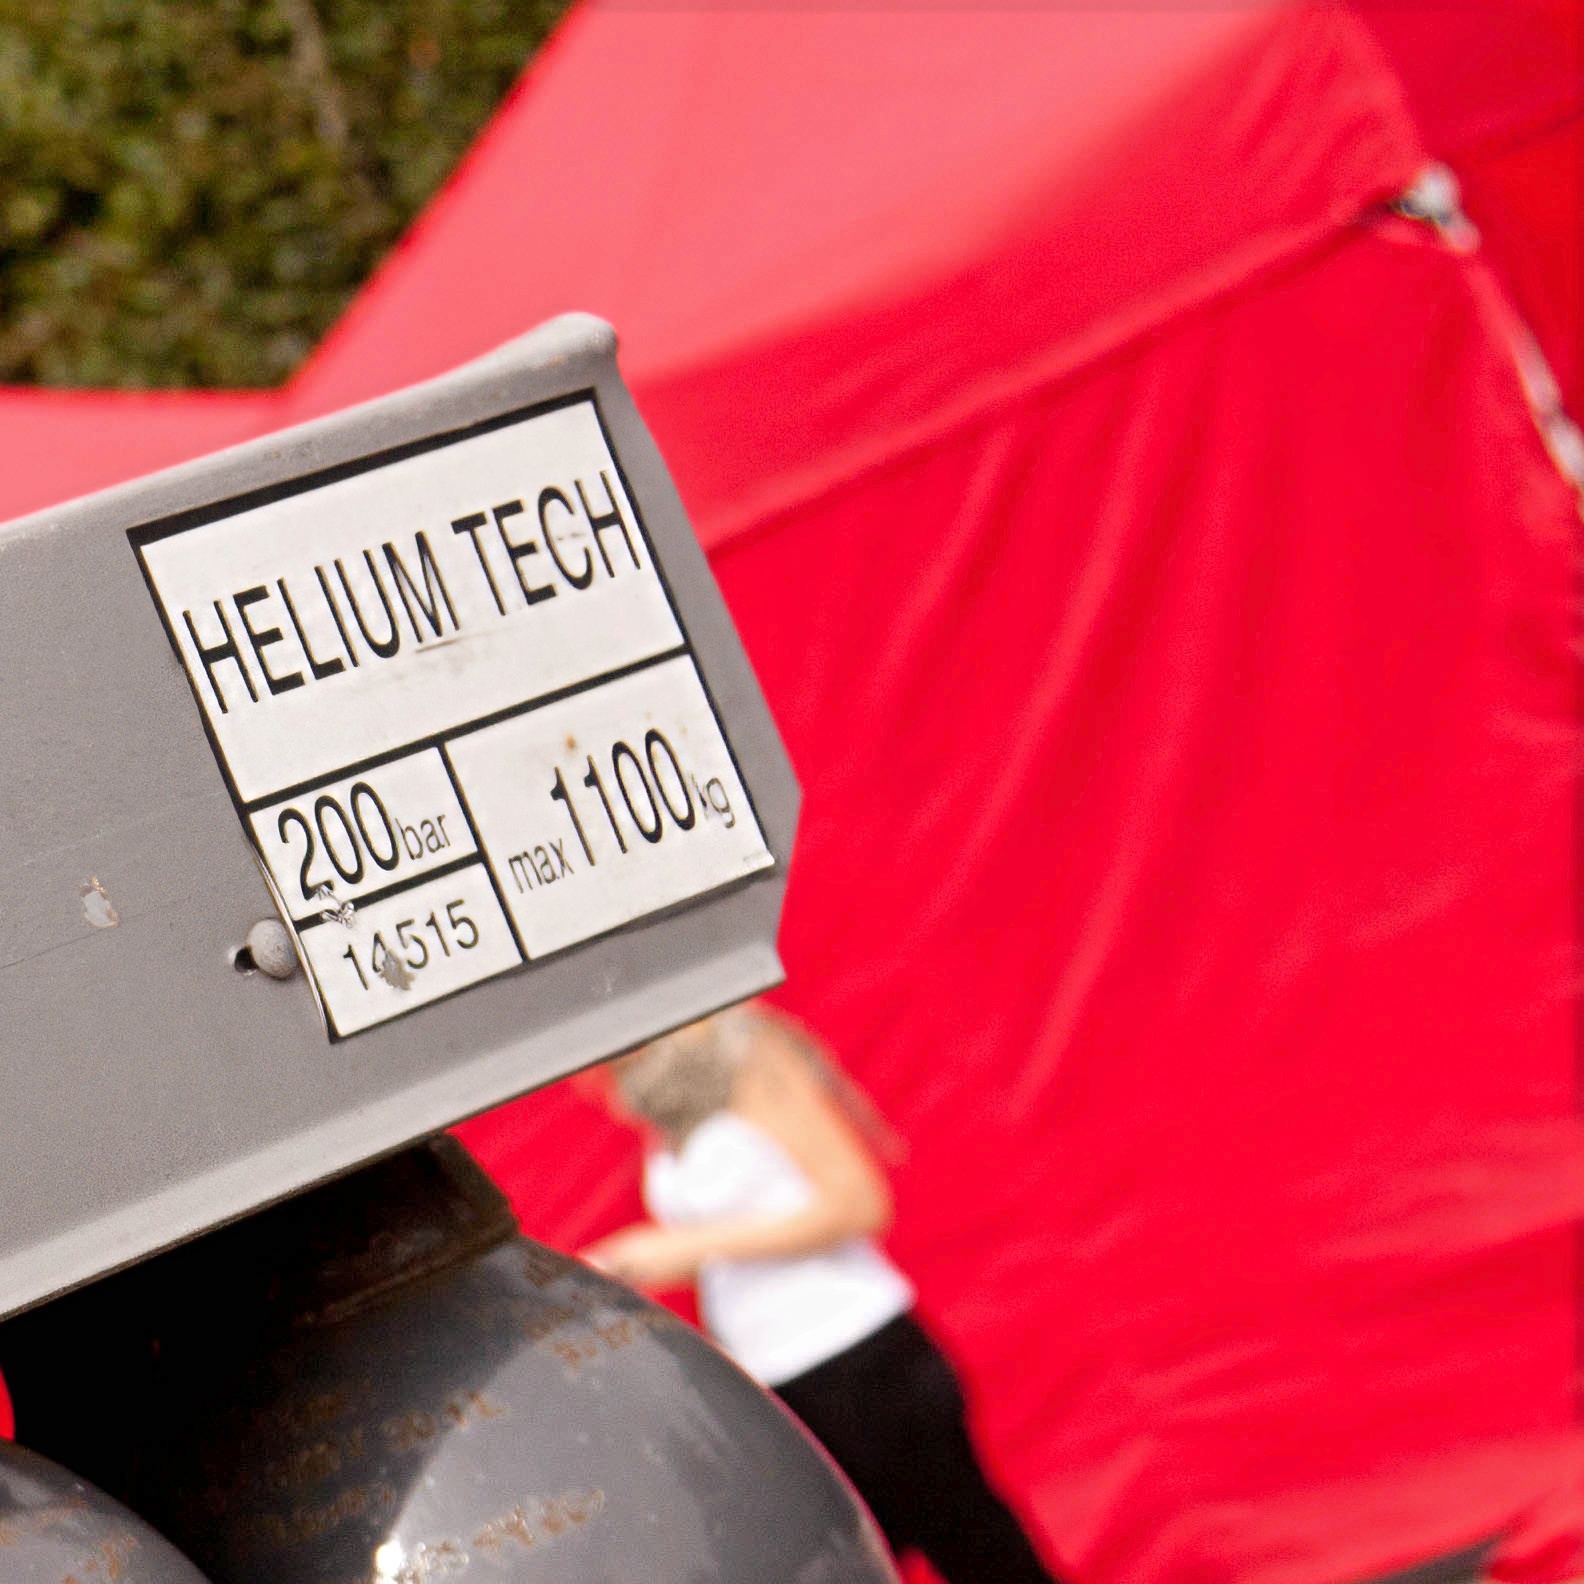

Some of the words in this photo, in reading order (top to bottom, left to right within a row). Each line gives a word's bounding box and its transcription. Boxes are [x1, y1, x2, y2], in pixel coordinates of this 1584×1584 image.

[182, 530, 461, 716] HELIUM
[450, 469, 642, 616] TECH
[277, 781, 400, 900] 200
[395, 814, 452, 861] bar
[508, 838, 574, 894] max
[550, 728, 696, 867] 1100
